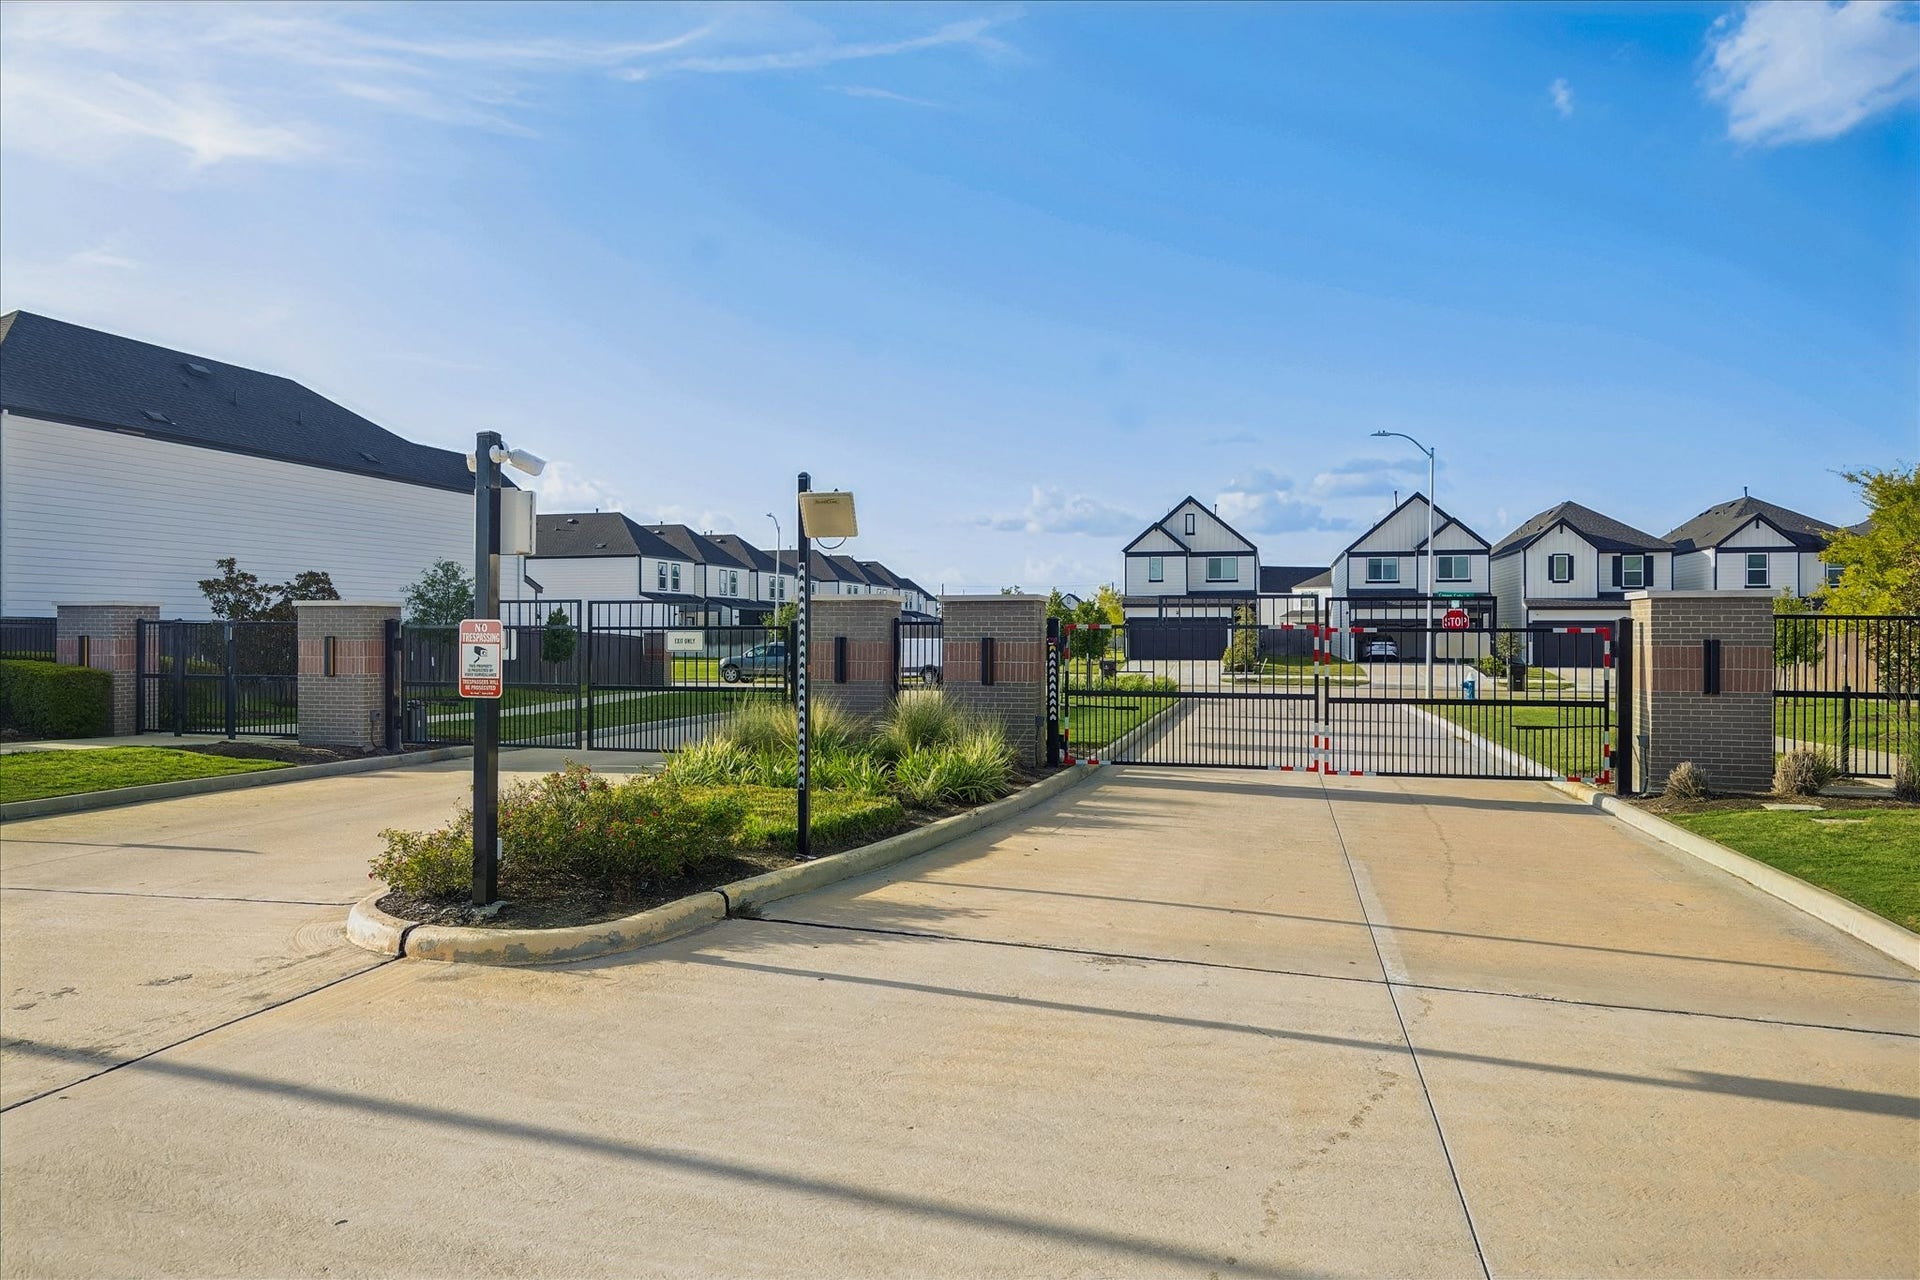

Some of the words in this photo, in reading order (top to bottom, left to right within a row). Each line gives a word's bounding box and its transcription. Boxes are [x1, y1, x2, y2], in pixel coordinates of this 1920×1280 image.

[1444, 617, 1468, 627] STOP
[474, 623, 488, 632] NO
[462, 632, 500, 643] TRESPASSING
